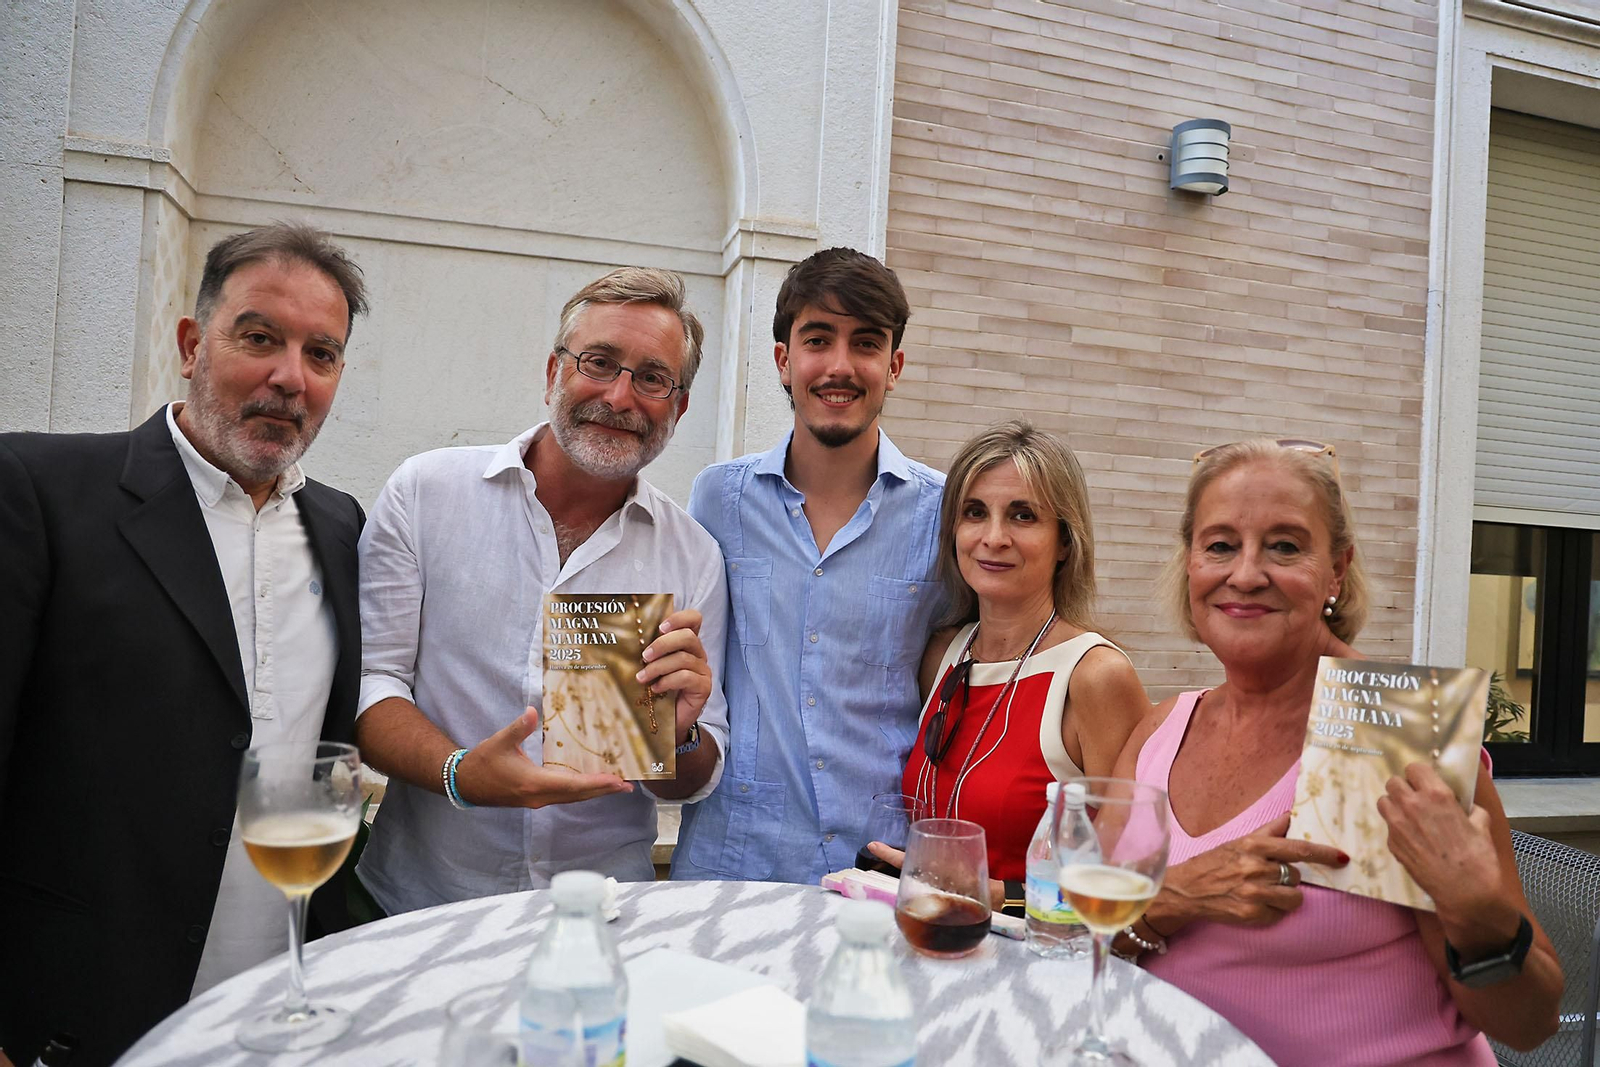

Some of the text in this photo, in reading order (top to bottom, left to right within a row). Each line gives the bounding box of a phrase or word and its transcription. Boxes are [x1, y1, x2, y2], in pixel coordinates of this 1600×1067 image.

[550, 599, 626, 614] PROCESIÓN
[550, 617, 600, 629] MAGNA
[550, 632, 618, 645] MARIANA
[550, 648, 581, 661] 2025
[1325, 669, 1421, 691] PROCESIÓN
[1322, 686, 1382, 706] MAGNA
[1319, 704, 1403, 728] MARIANA
[1314, 721, 1355, 739] 2025
